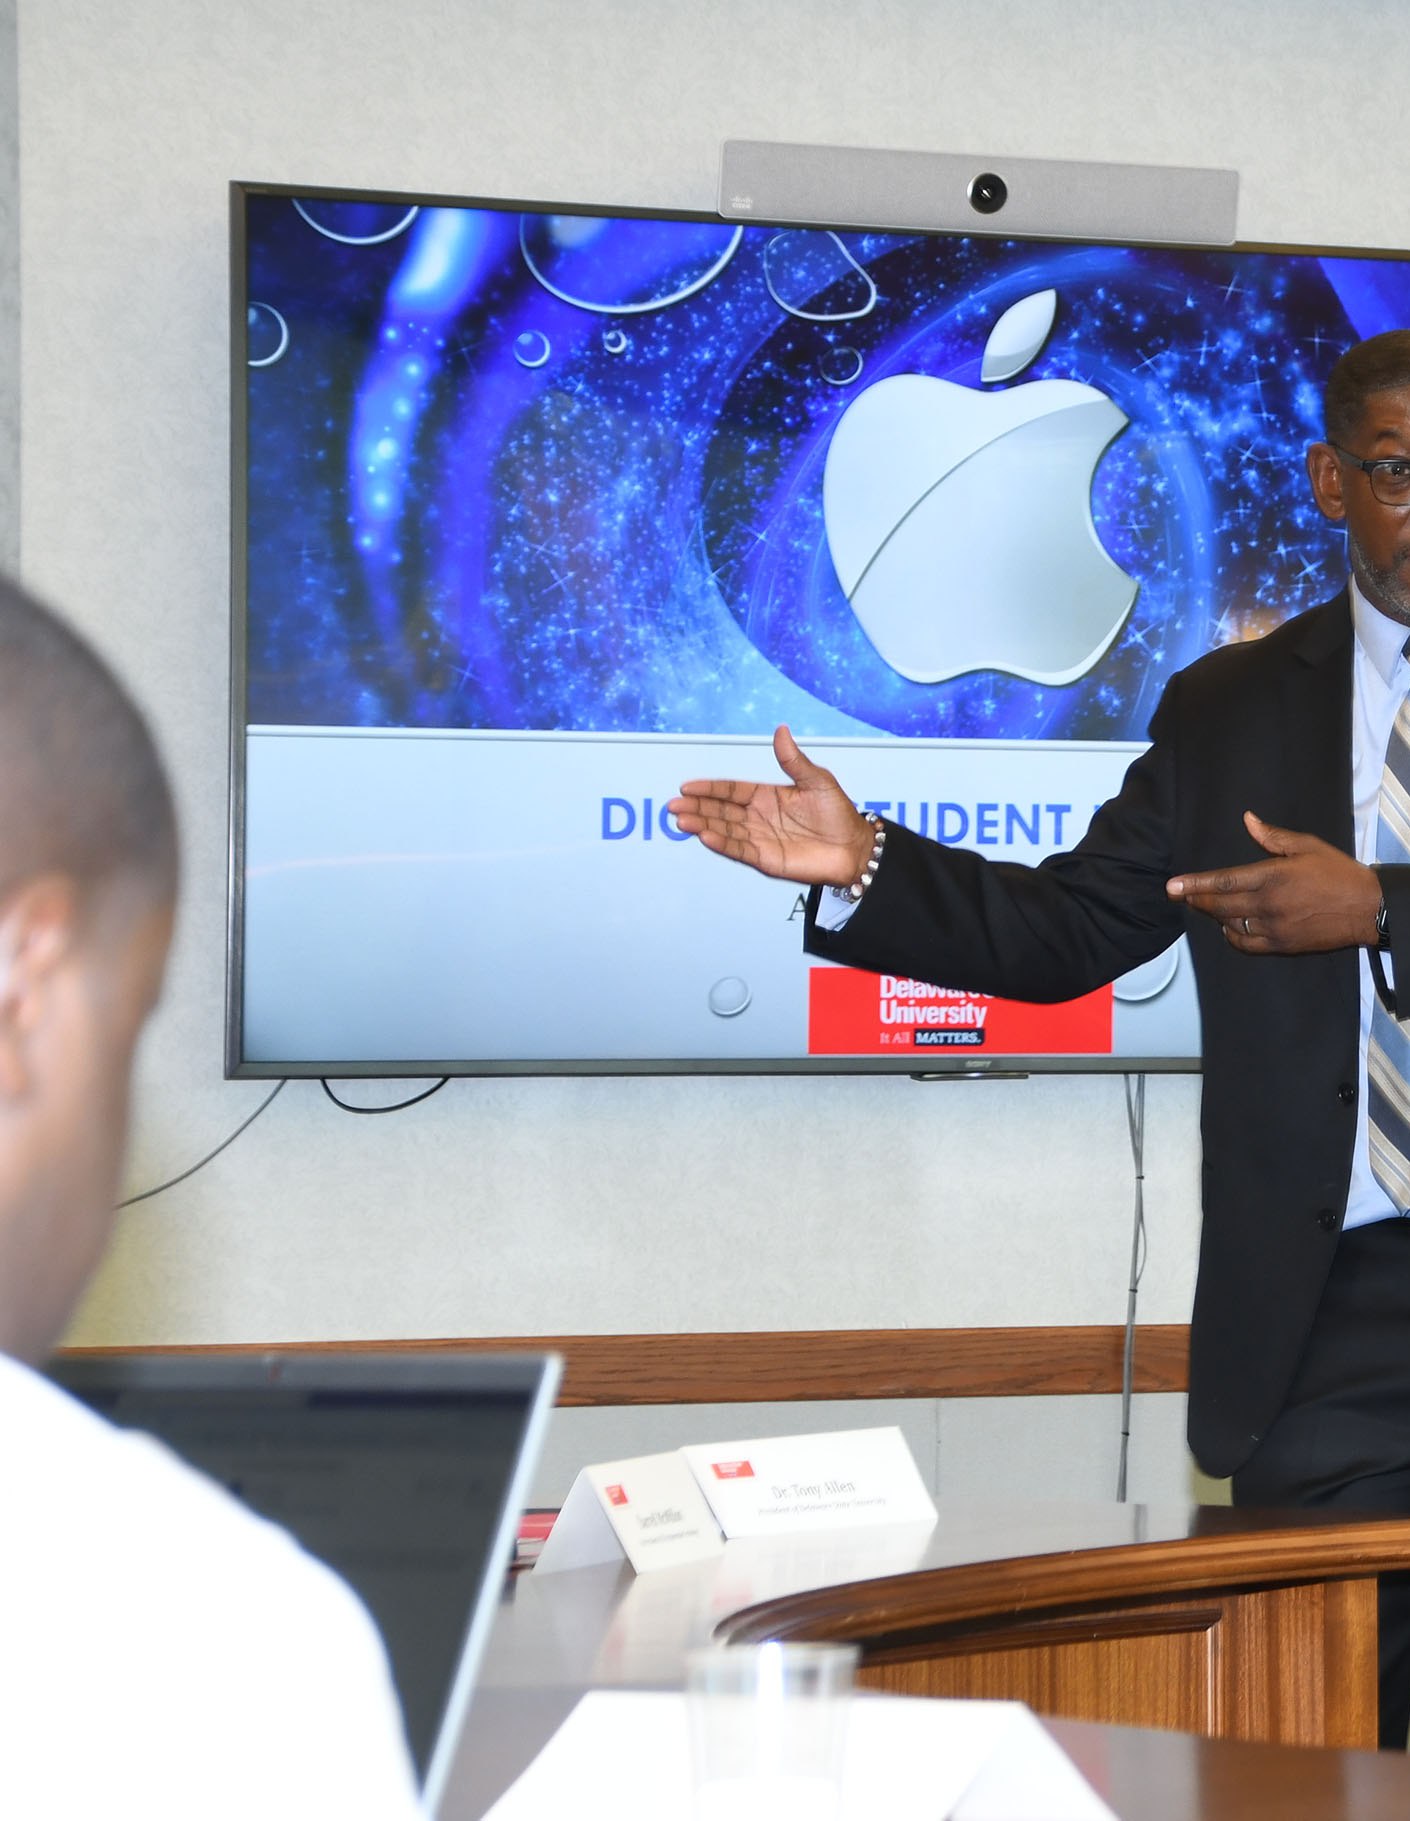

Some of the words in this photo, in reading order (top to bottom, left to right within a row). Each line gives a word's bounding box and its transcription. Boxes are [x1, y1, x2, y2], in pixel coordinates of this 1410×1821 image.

[854, 800, 1071, 845] TUDENT
[880, 999, 987, 1028] University
[916, 1032, 982, 1044] MATTERS.
[791, 1483, 821, 1499] Tony
[824, 1480, 856, 1495] Allen
